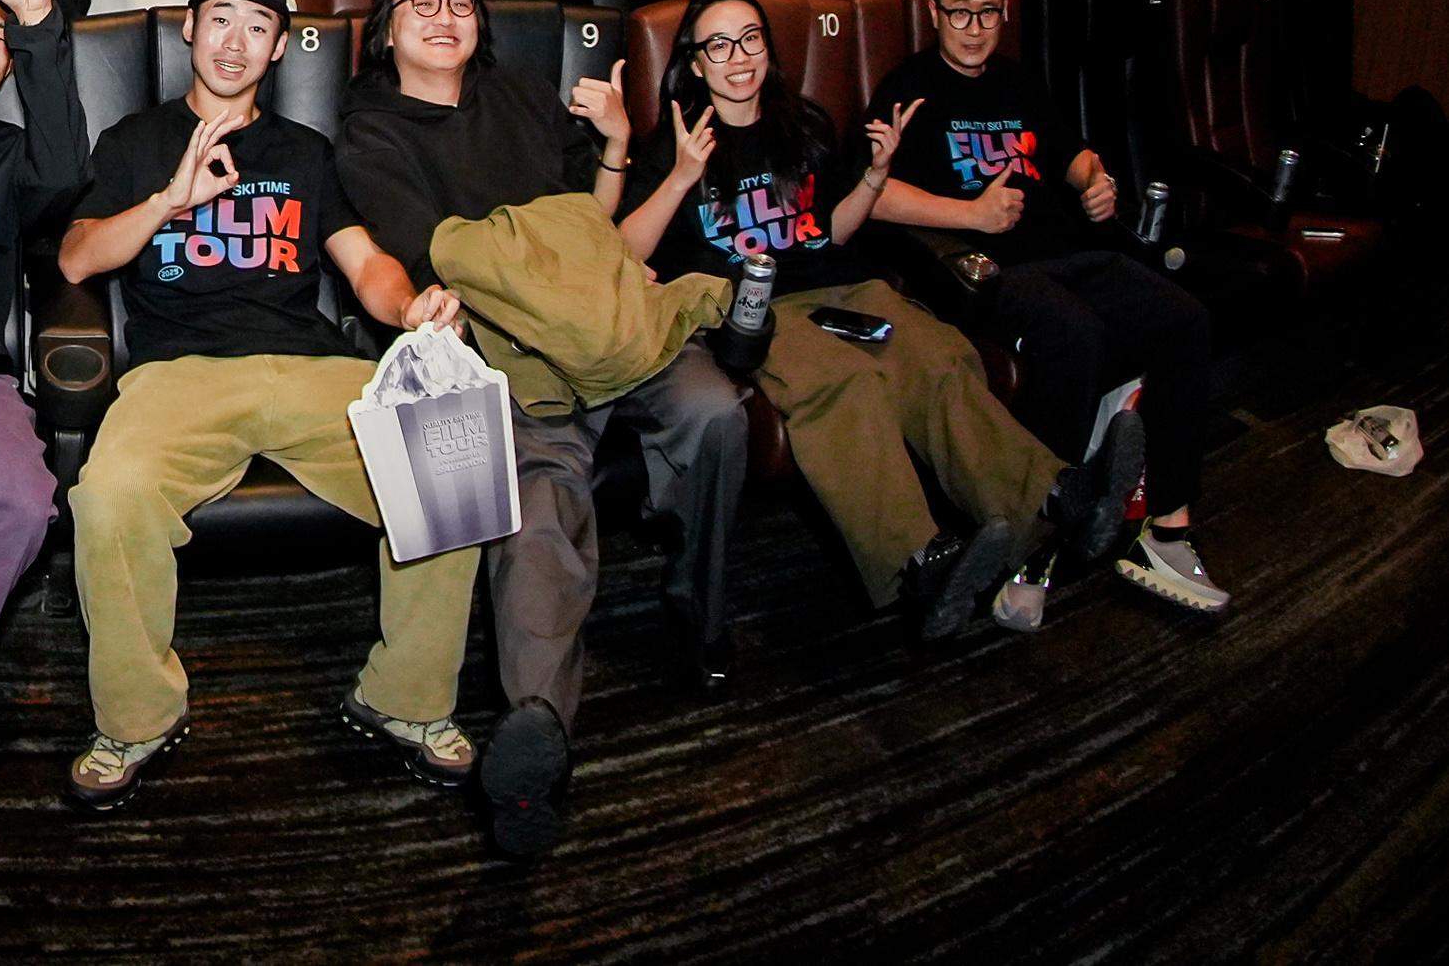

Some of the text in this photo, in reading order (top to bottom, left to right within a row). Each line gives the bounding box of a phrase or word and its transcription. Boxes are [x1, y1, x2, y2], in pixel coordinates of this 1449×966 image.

[581, 22, 600, 48] 9
[818, 12, 841, 37] 10
[301, 26, 321, 52] 8
[945, 131, 1038, 160] FILM
[231, 181, 292, 197] SKI TIME
[152, 232, 301, 274] TOUR
[423, 417, 487, 446] FILM
[426, 435, 489, 458] TOUR
[435, 458, 487, 476] SALOMON
